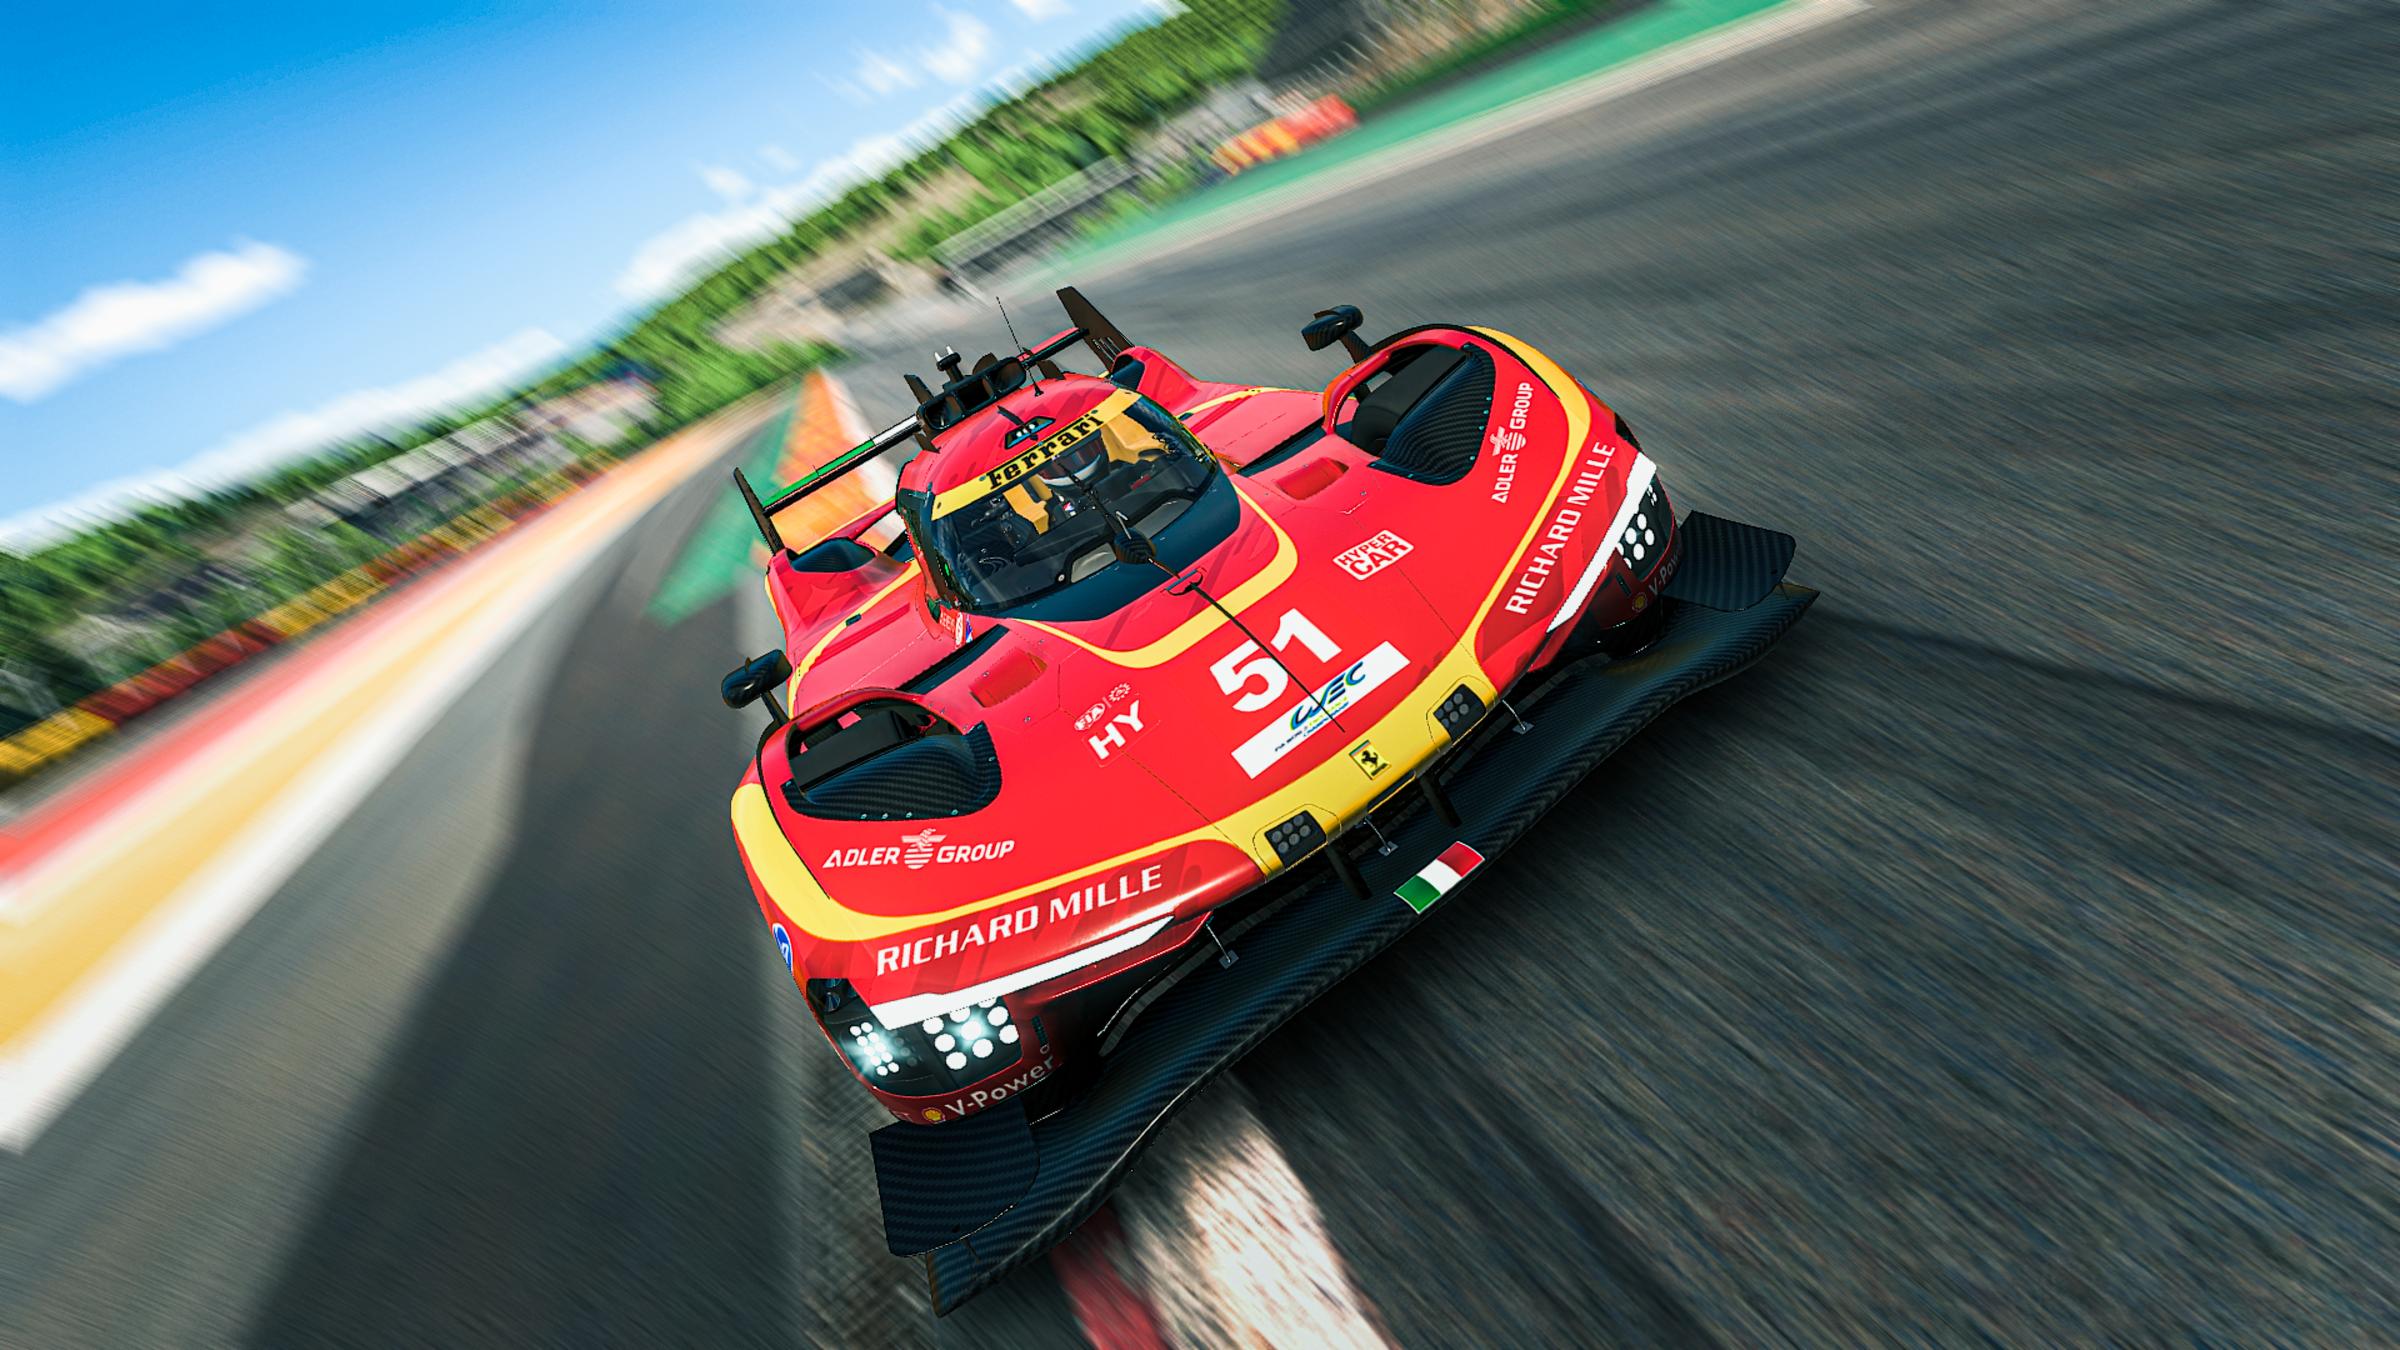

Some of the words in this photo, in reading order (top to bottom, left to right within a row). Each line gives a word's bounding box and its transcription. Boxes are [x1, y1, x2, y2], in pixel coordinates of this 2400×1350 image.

[986, 414, 1104, 489] Ferrari
[1491, 453, 1518, 504] ADLER
[1509, 382, 1534, 430] GROUP
[1338, 533, 1392, 566] HYPER
[1349, 541, 1408, 575] CAR
[1504, 509, 1582, 615] RICHARD
[1567, 441, 1616, 506] MILLE
[1209, 608, 1343, 712] 51
[1074, 703, 1106, 731] FIA
[1290, 661, 1366, 730] WEC
[1088, 699, 1145, 760] HY
[822, 845, 901, 869] ADLER
[936, 839, 1015, 864] GROUP
[876, 910, 1039, 976] RICHARD
[1048, 864, 1164, 924] MILLE
[944, 1054, 1055, 1117] V-Power
